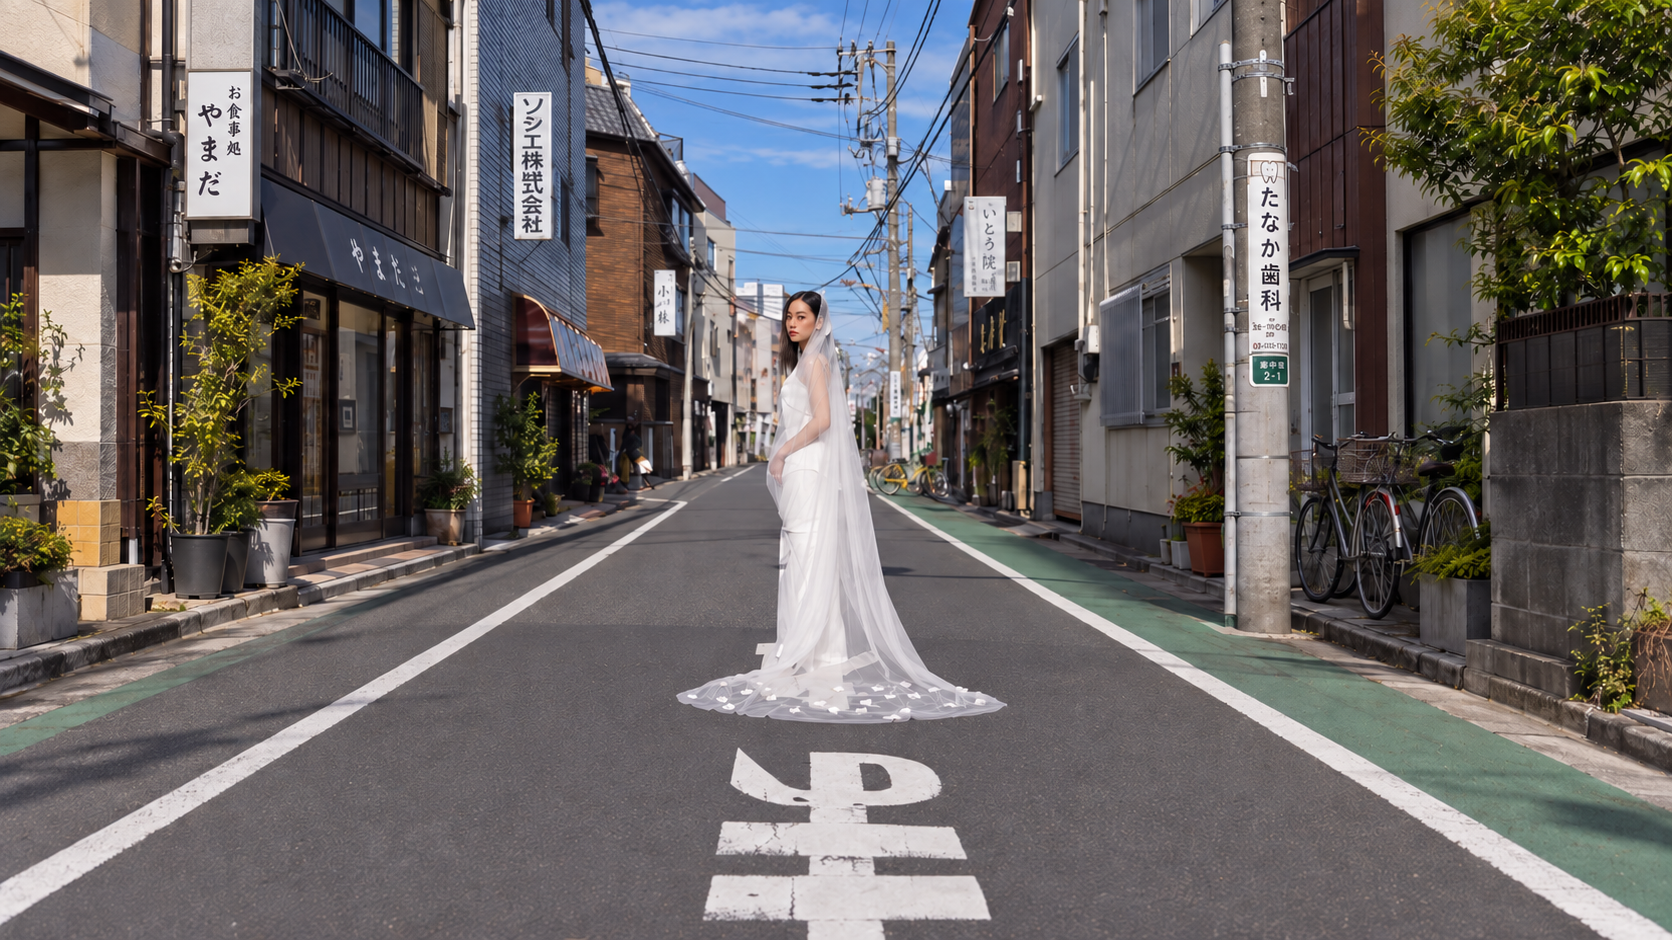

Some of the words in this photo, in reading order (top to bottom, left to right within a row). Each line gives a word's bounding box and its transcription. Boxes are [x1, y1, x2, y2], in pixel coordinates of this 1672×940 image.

[197, 103, 222, 197] やまだ
[226, 86, 243, 157] お食事処
[521, 97, 544, 234] ソシエ株式会社
[1260, 186, 1282, 312] たなか歯科
[1264, 371, 1281, 381] 2-1
